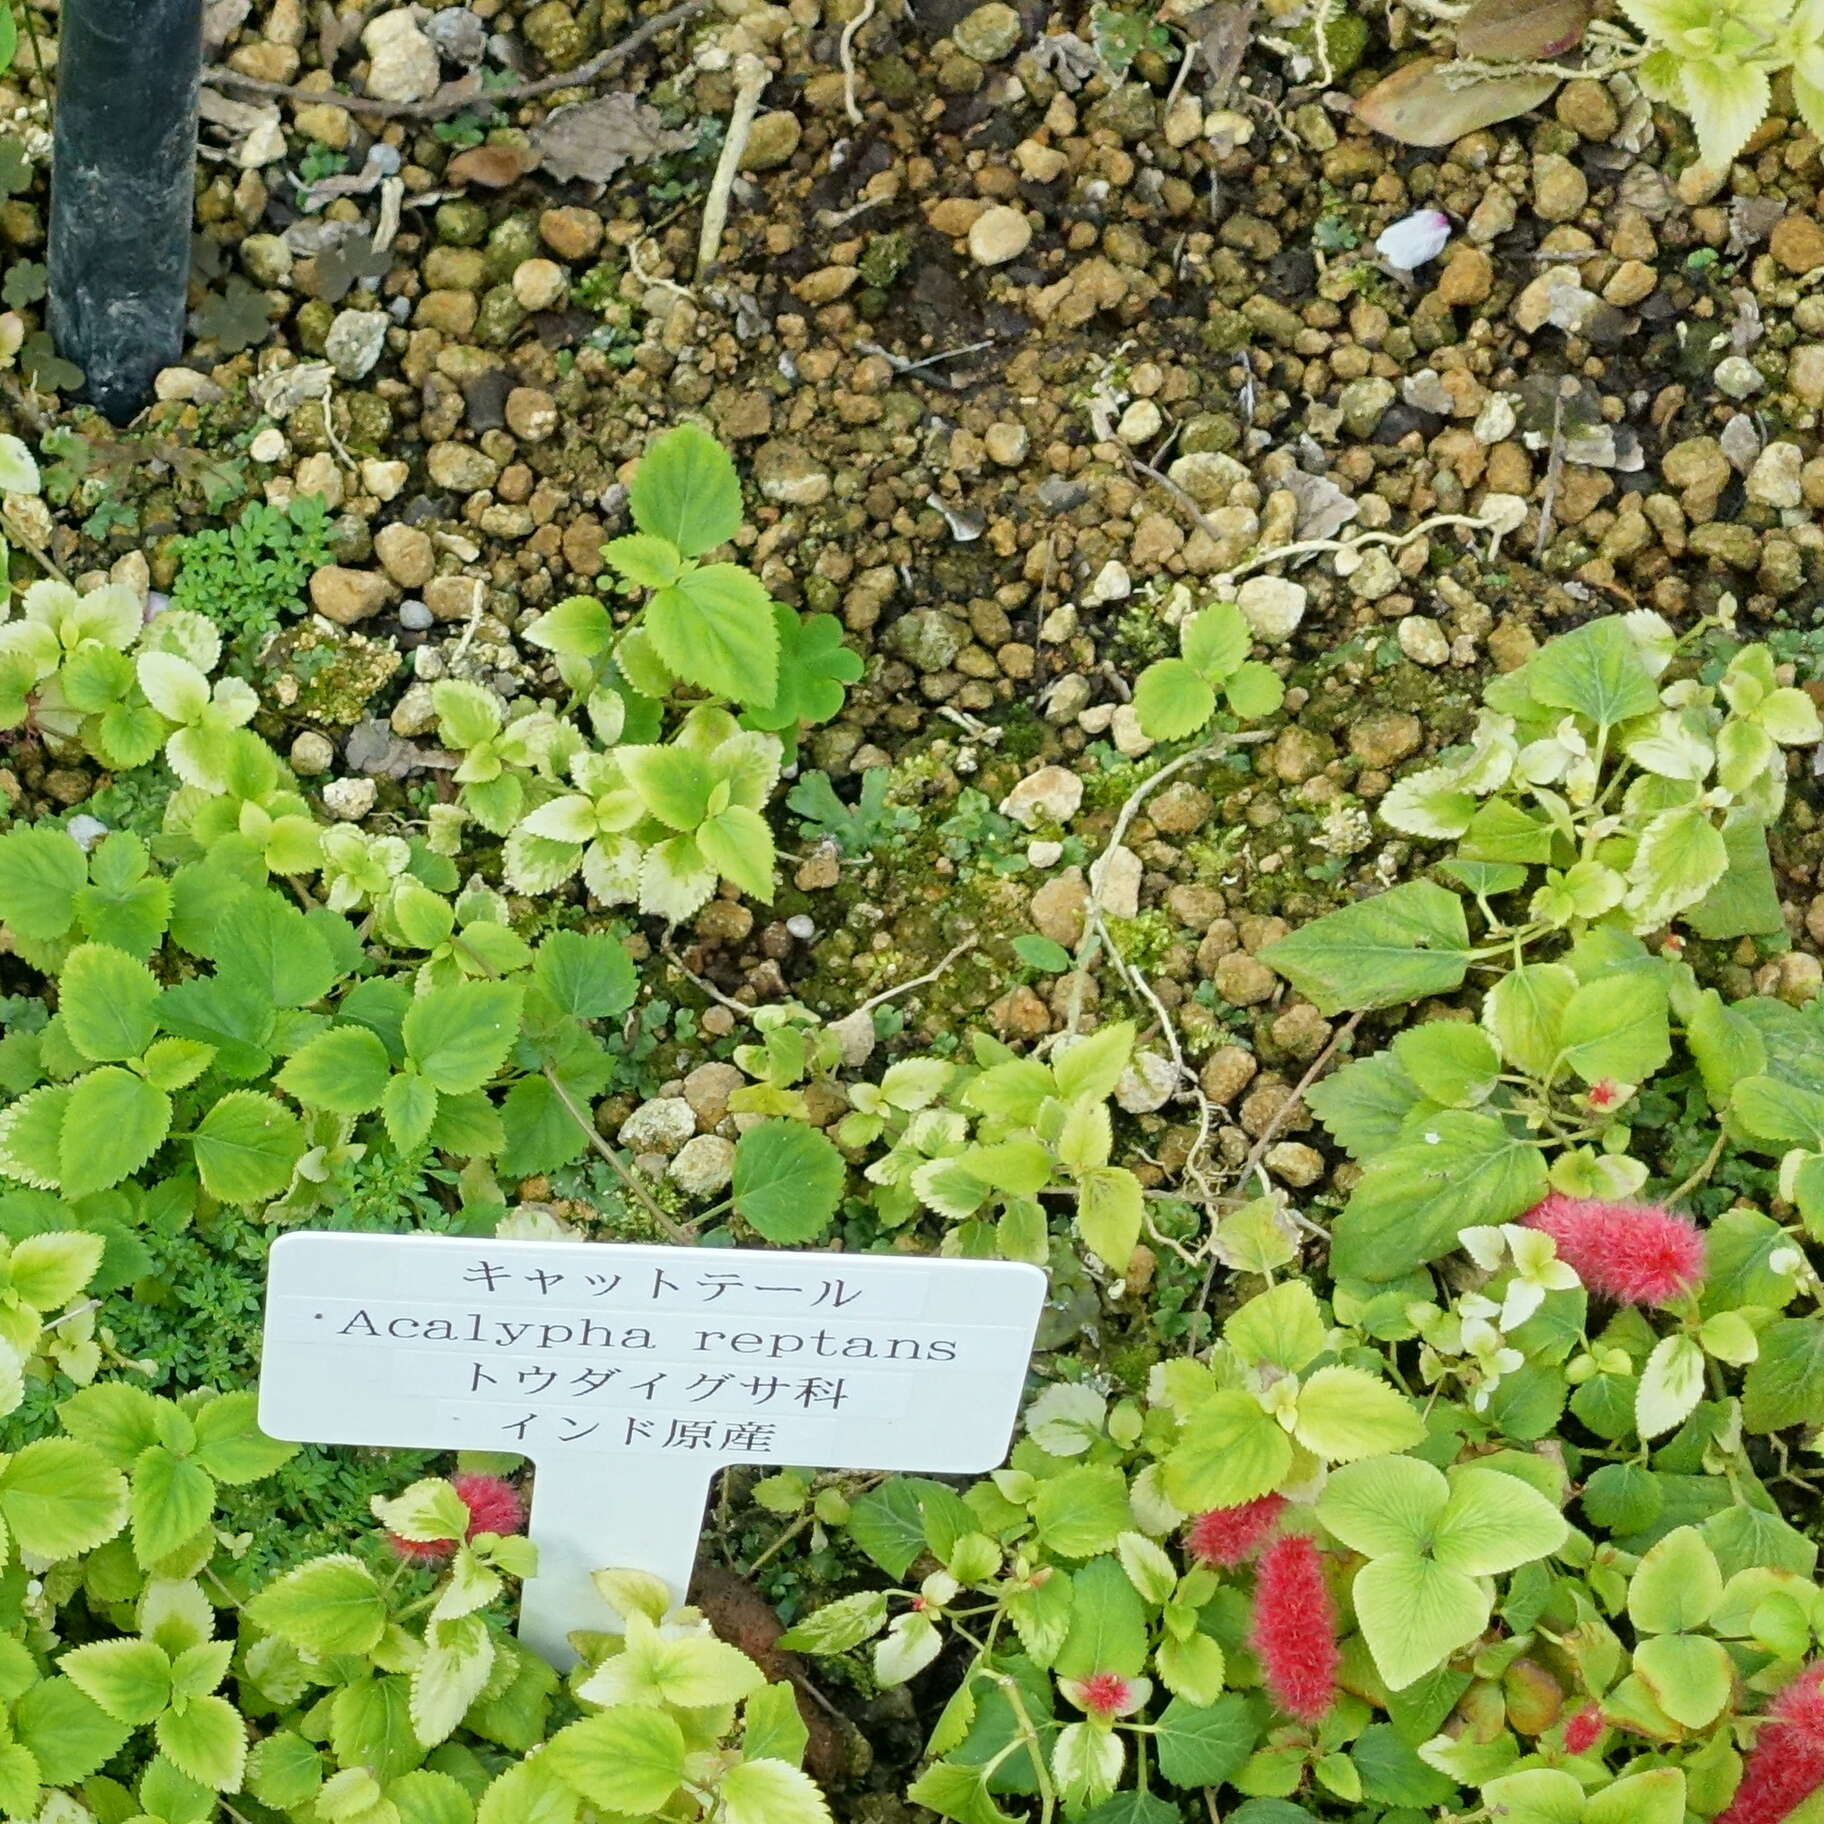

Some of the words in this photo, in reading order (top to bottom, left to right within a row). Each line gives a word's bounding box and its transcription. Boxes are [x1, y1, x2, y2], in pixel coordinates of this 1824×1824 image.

[463, 1260, 863, 1309] キャットテール
[337, 1309, 657, 1350] Acalypha
[693, 1329, 957, 1362] reptans
[471, 1361, 850, 1411] トウダイグサ科
[501, 1412, 777, 1454] インド原産
